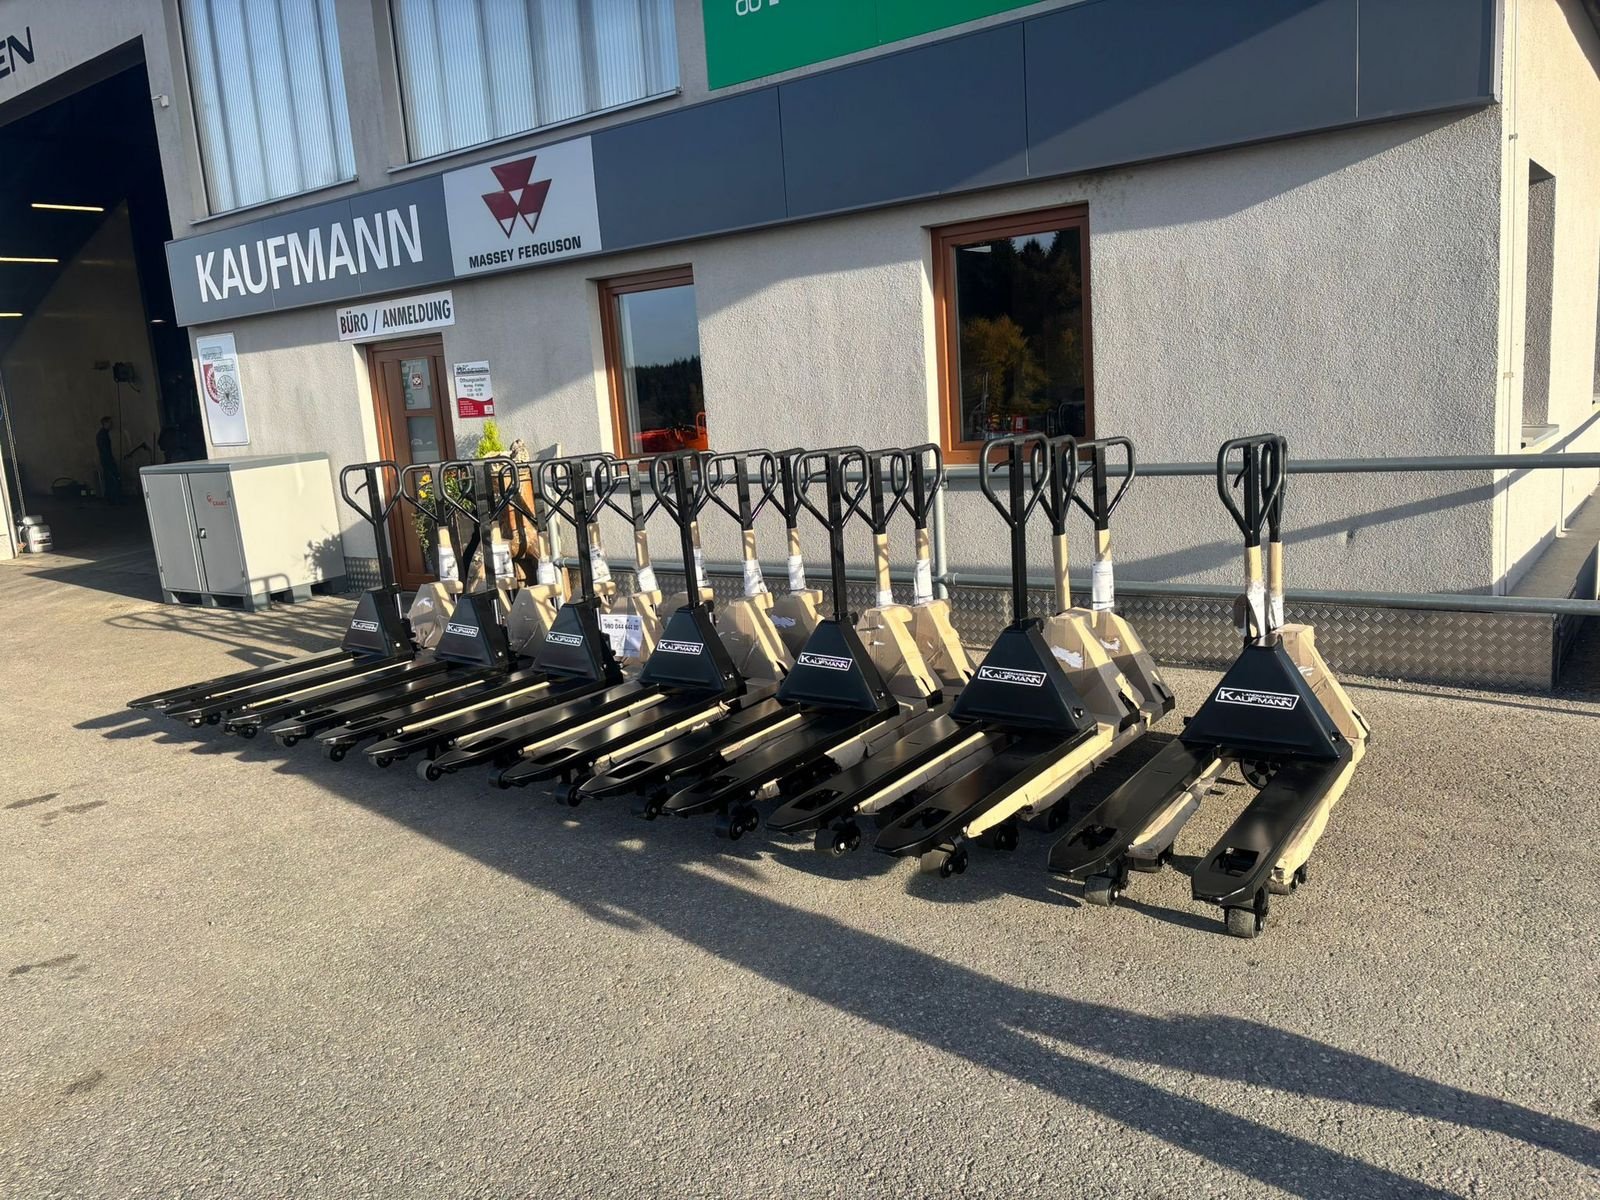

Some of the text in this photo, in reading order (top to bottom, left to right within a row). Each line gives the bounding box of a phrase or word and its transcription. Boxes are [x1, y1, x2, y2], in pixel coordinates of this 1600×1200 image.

[195, 204, 423, 303] KAUFMANN
[469, 236, 582, 269] MASSEY FERGUSON
[340, 310, 368, 334] BÜRO
[382, 299, 451, 329] ANMELDUNG
[660, 642, 700, 652] KAUFMANN
[801, 655, 848, 669] KAUFMANN
[982, 669, 1041, 684] KAUFMANN
[1221, 691, 1293, 707] KAUFMANN
